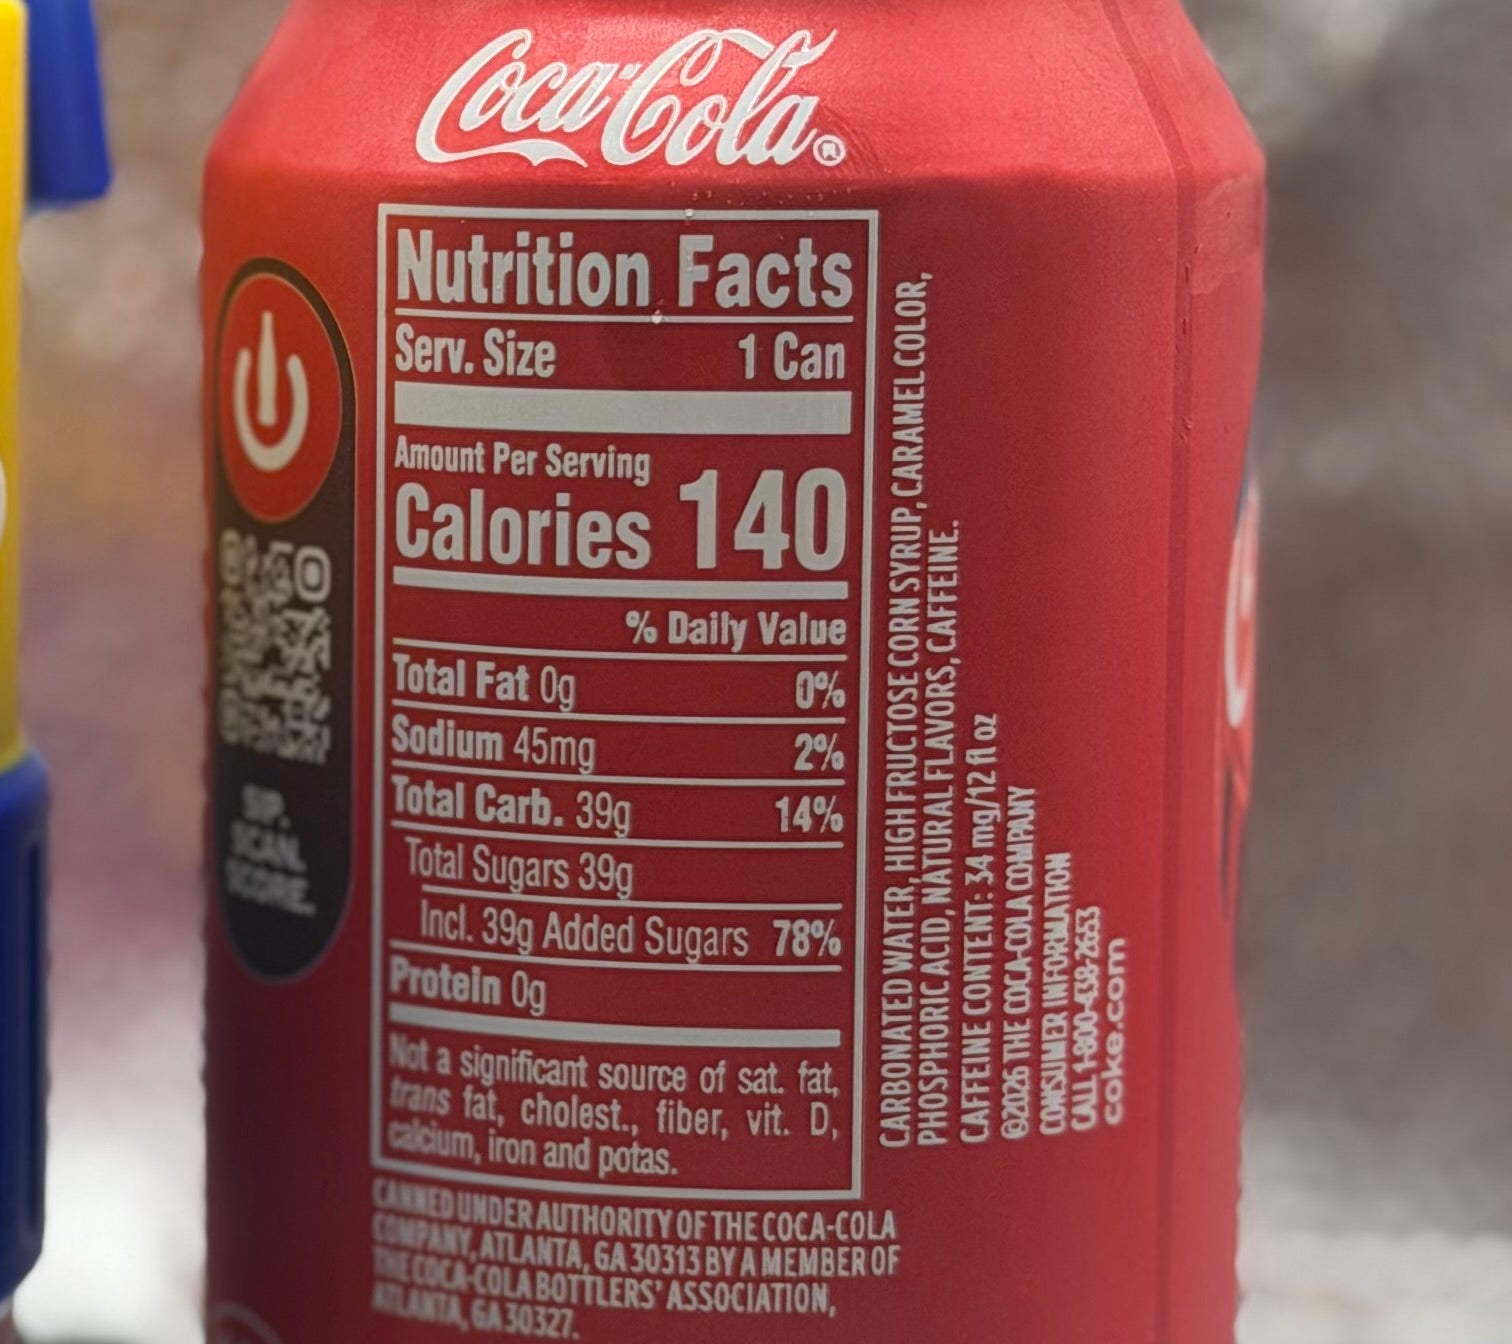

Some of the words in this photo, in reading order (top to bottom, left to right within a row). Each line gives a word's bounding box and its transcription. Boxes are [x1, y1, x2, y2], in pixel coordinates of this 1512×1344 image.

[416, 28, 837, 166] Coca-Cola
[397, 229, 650, 306] Nutrition
[678, 235, 853, 309] Facts
[395, 323, 475, 374] Serv.
[484, 328, 556, 378] Size
[739, 333, 755, 380] 1
[774, 332, 845, 381] Can
[894, 272, 933, 366] COLOR,
[394, 435, 485, 474] Amount
[493, 442, 534, 475] Per
[545, 444, 651, 486] Serving
[891, 371, 925, 497] CARAMEL
[396, 483, 651, 569] Calories
[680, 468, 847, 571] 140
[890, 501, 928, 592] SYRUP,
[927, 519, 959, 652] CAFFEINE.
[626, 611, 657, 644] %
[669, 611, 747, 651] Daily
[758, 613, 847, 646] Value
[888, 597, 920, 667] CORN
[392, 654, 464, 697] Total
[477, 662, 529, 702] Fat
[541, 666, 575, 712] 0g
[795, 670, 845, 710] 0%
[392, 714, 503, 761] Sodium
[514, 727, 595, 775] 45mg
[794, 733, 845, 771] 2%
[885, 671, 919, 802] FRUCTOSE
[924, 657, 962, 779] FLAVORS,
[973, 714, 997, 741] oz
[966, 746, 997, 765] fl
[392, 775, 464, 819] Total
[475, 784, 563, 827] Carb.
[576, 791, 632, 838] 39g
[775, 795, 843, 832] 14%
[885, 808, 915, 871] HIGH
[966, 770, 1000, 847] mg/12
[1006, 785, 1036, 891] COMPANY
[405, 836, 463, 880] Total
[473, 844, 569, 893] Sugars
[578, 854, 633, 900] 39g
[921, 785, 954, 904] NATURAL
[964, 854, 994, 884] 34
[421, 899, 473, 942] Incl.
[482, 907, 534, 954] 39g
[542, 912, 634, 954] Added
[645, 916, 748, 964] Sugars
[773, 918, 841, 957] 78%
[883, 876, 922, 973] WATER,
[920, 908, 956, 976] ACID,
[962, 892, 994, 1015] CONTENT:
[1004, 895, 1033, 1014] COCA-COLA
[1042, 852, 1071, 1008] INFORMATION
[390, 957, 501, 1004] Protein
[511, 971, 546, 1016] 0g
[390, 1032, 429, 1071] Not
[436, 1046, 451, 1071] a
[461, 1046, 588, 1088] significant
[598, 1060, 686, 1092] source
[699, 1061, 726, 1093] of
[738, 1062, 784, 1094] sat.
[799, 1061, 839, 1096] fat,
[880, 979, 913, 1148] CARBONATED
[918, 981, 950, 1146] PHOSPHORIC
[1002, 1019, 1031, 1063] THE
[1101, 938, 1126, 1125] coke.com
[960, 1020, 992, 1143] CAFFEINE
[1039, 1012, 1069, 1134] CONSUMER
[1071, 1074, 1098, 1130] CALL
[390, 1077, 451, 1114] trans
[464, 1086, 505, 1127] fat,
[520, 1093, 638, 1136] cholest.,
[657, 1101, 727, 1140] fiber,
[747, 1104, 790, 1136] vit.
[810, 1105, 838, 1140] D,
[389, 1118, 481, 1164] calcium,
[488, 1132, 536, 1164] iron
[543, 1138, 589, 1170] and
[599, 1145, 677, 1178] potas.
[457, 1191, 534, 1229] UNDER
[536, 1201, 675, 1239] AUTHORITY
[676, 1208, 708, 1239] OF
[711, 1209, 757, 1241] THE
[761, 1209, 896, 1241] COCA-COLA
[411, 1251, 535, 1300] COCA-COLA
[666, 1281, 837, 1317] ASSOCIATION,
[480, 1230, 589, 1273] ATLANTA,
[594, 1241, 627, 1271] GA
[630, 1243, 700, 1276] 30313
[706, 1246, 735, 1276] BY
[739, 1247, 757, 1276] A
[761, 1246, 865, 1277] MEMBER
[870, 1245, 900, 1275] OF
[472, 1303, 501, 1329] GA
[506, 1307, 580, 1339] 30327.
